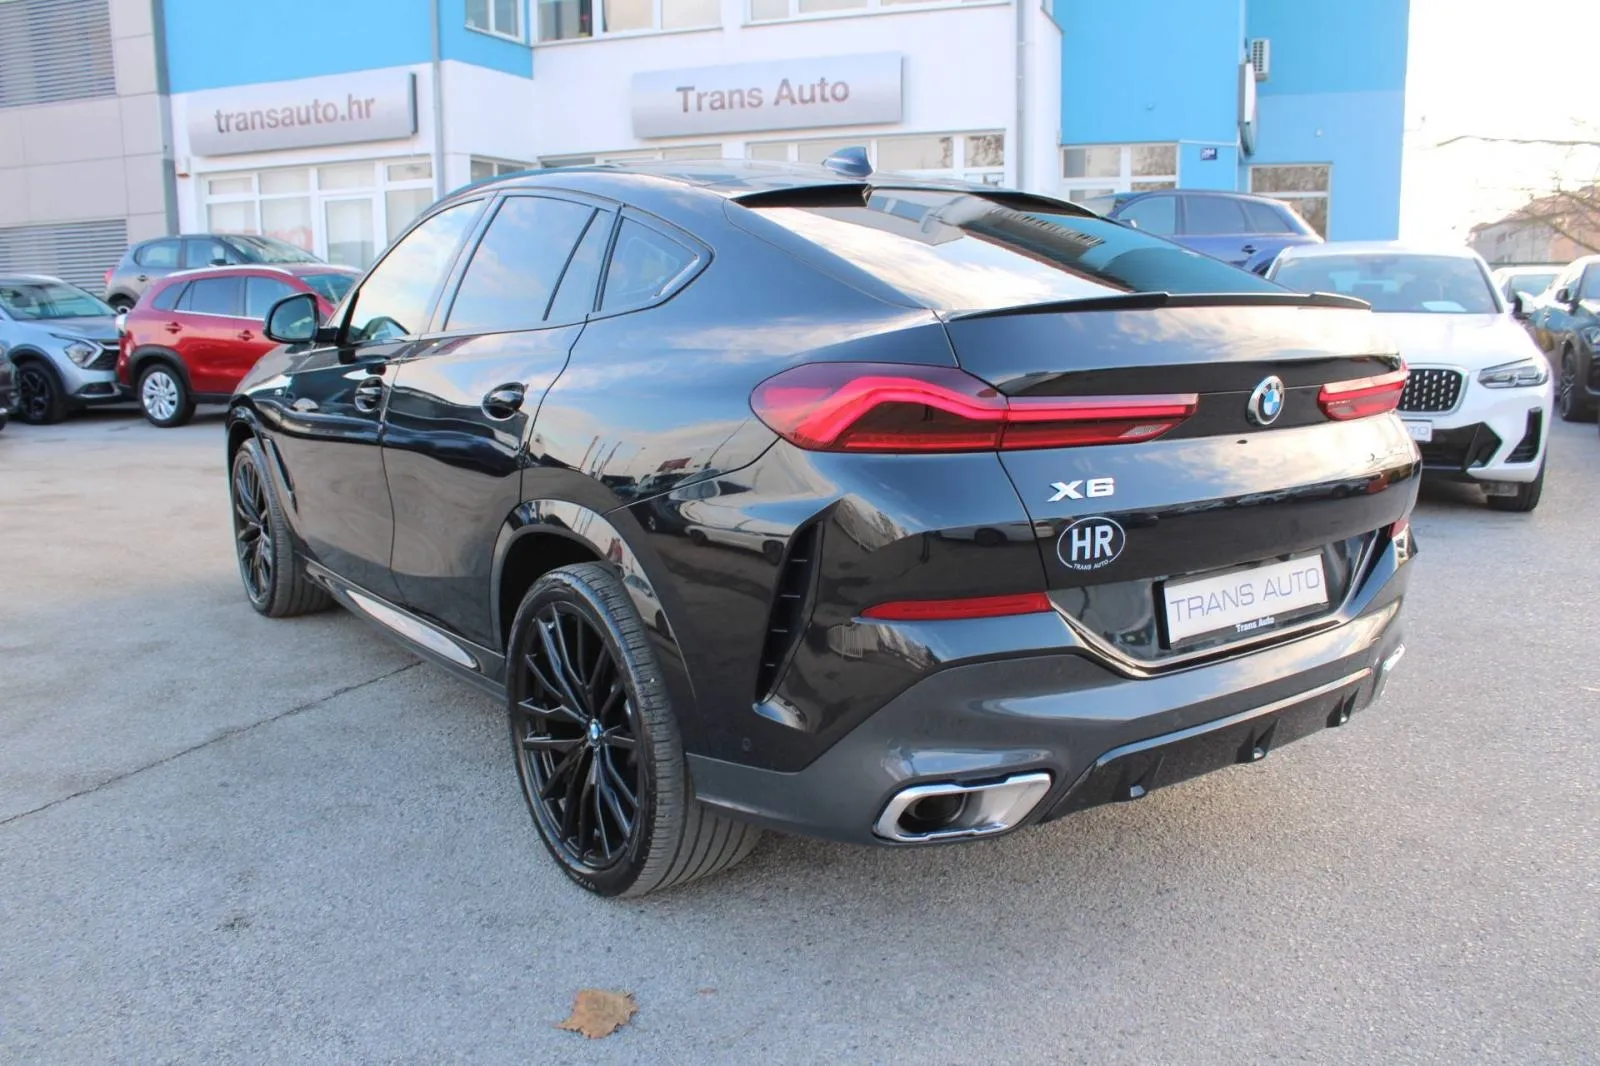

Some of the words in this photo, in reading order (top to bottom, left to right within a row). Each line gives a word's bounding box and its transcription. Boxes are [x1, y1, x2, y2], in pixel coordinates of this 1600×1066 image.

[675, 86, 764, 113] Trans
[773, 77, 850, 106] Auto
[214, 93, 376, 134] transauto.hr
[1047, 477, 1115, 502] X6
[1071, 524, 1114, 562] HR
[1073, 563, 1092, 571] TRANS
[1093, 559, 1110, 570] AUTO
[1170, 583, 1255, 622] TRANS
[1263, 567, 1321, 601] AUTO
[1235, 620, 1258, 633] Trans
[1258, 615, 1275, 628] Auto
